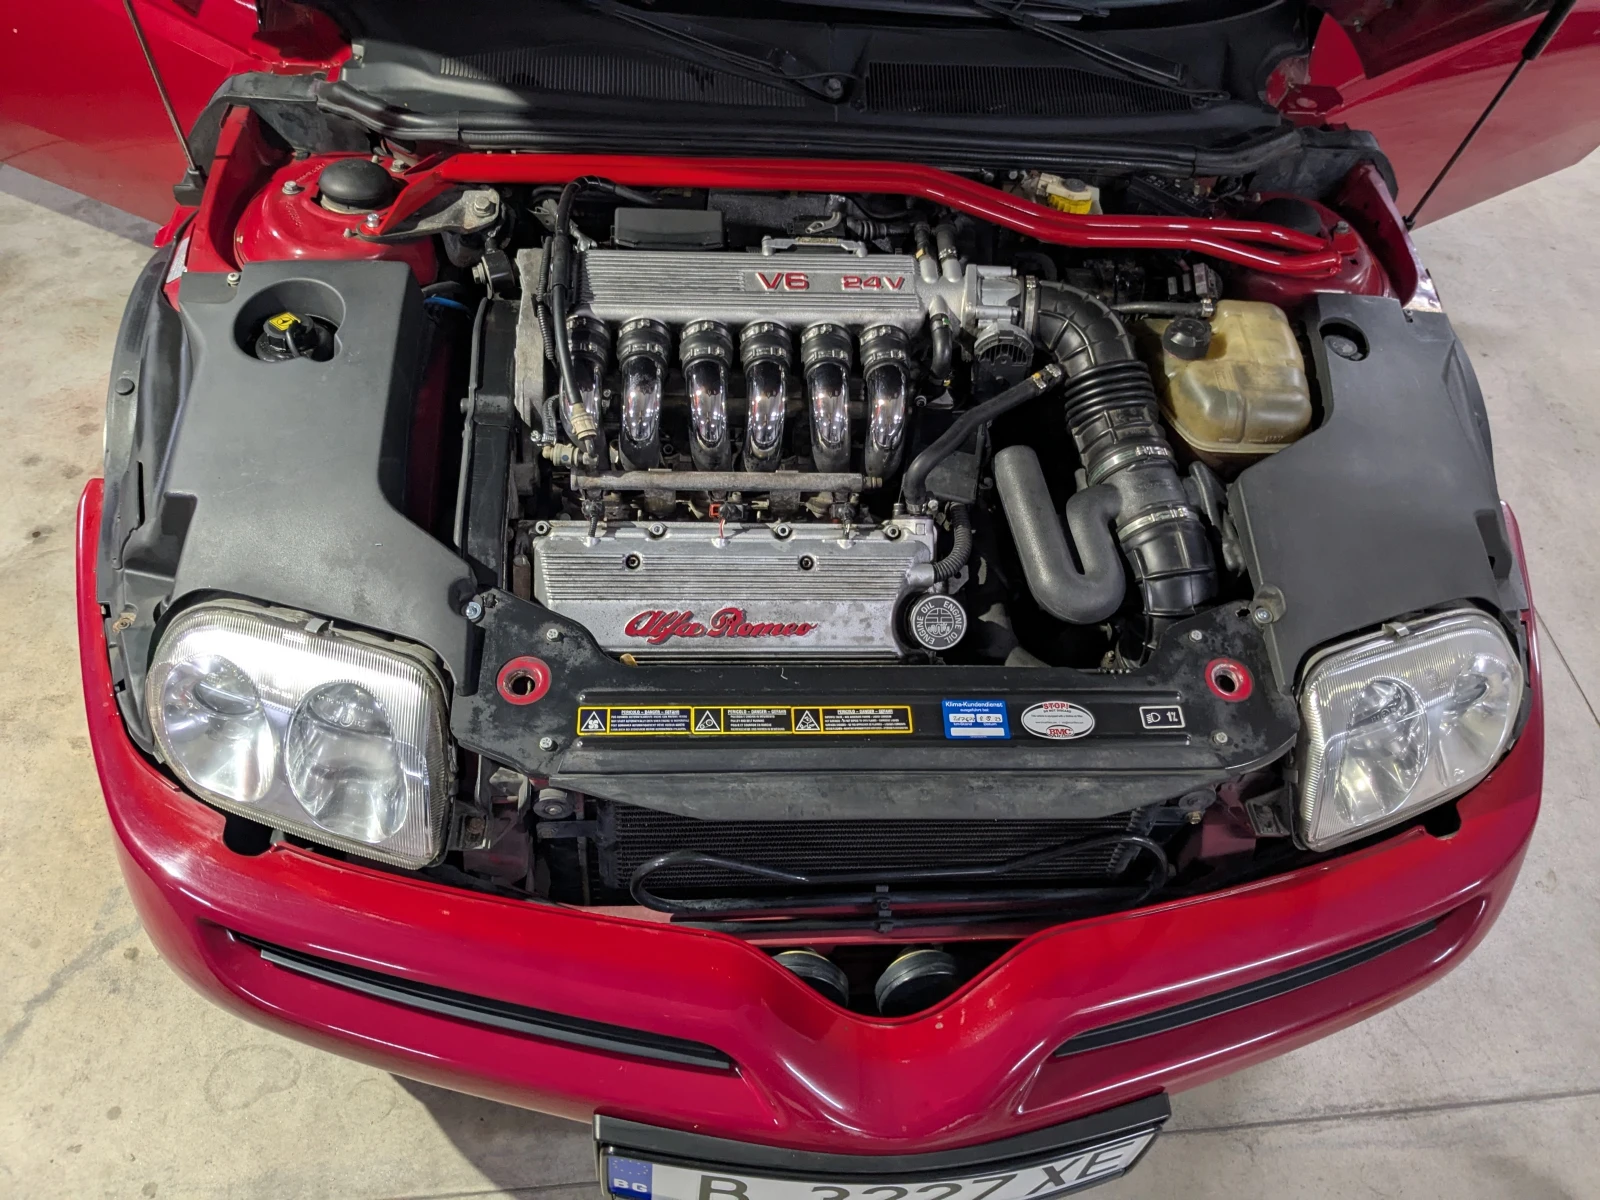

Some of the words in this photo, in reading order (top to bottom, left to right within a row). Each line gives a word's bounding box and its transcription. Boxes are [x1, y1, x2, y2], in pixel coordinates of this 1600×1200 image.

[756, 272, 809, 291] V6
[841, 275, 905, 291] 24V
[921, 602, 935, 614] OIL
[943, 600, 963, 630] ENGINE
[624, 610, 704, 645] Alfa
[706, 607, 818, 638] Romeo
[916, 615, 936, 645] ENGINE
[943, 631, 958, 644] OIL
[1024, 1140, 1136, 1196] XE
[613, 1178, 648, 1193] BG
